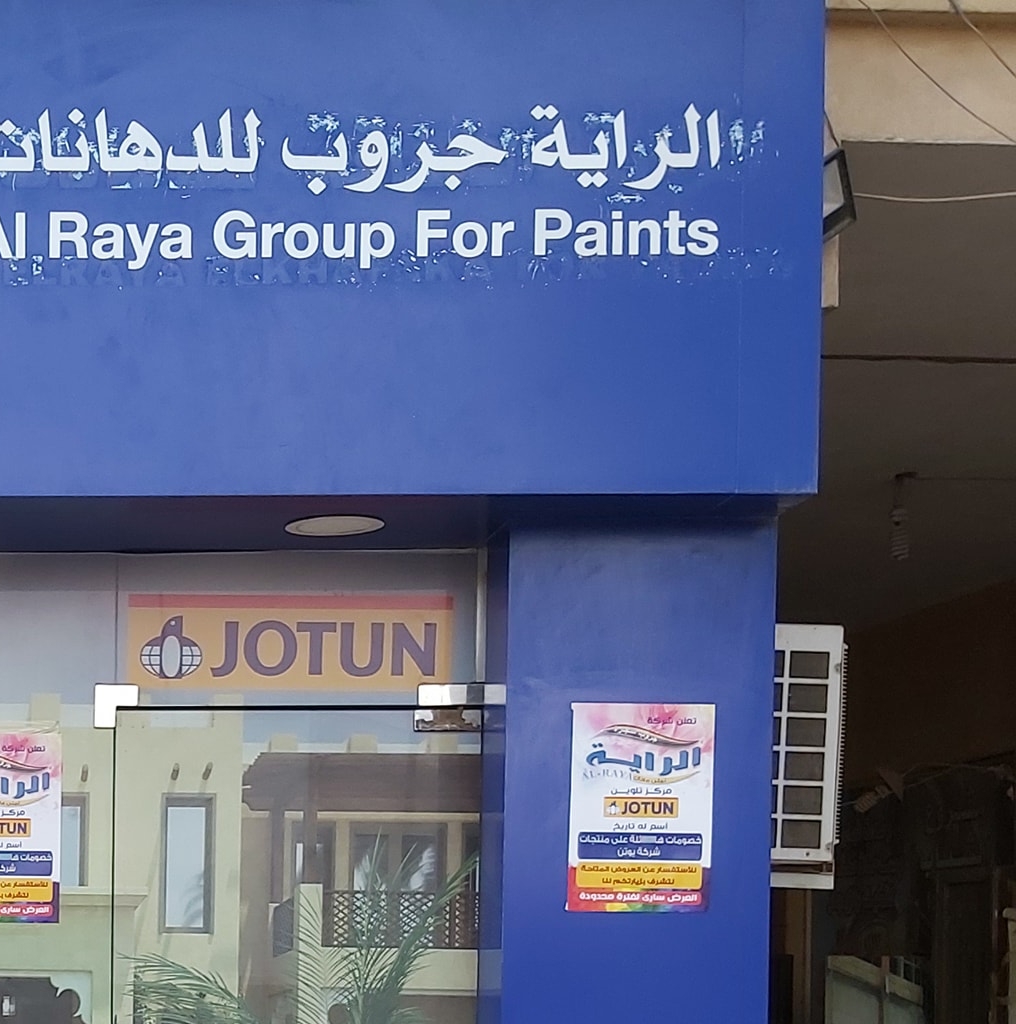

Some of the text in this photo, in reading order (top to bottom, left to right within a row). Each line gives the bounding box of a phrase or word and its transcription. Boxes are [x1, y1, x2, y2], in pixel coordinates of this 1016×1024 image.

[530, 103, 721, 190] الراية
[281, 126, 508, 193] جروب
[49, 211, 194, 269] Raya
[213, 209, 396, 269] Group
[417, 210, 516, 258] For
[533, 207, 721, 257] Paints
[210, 620, 438, 677] JOTUN
[586, 742, 702, 776] الراية
[611, 787, 672, 795] مركز تلوين
[621, 801, 674, 815] JOTUN
[580, 834, 609, 846] منتجات
[666, 835, 702, 845] خصومات
[20, 852, 53, 862] خصومات
[637, 846, 661, 857] شركة
[579, 892, 614, 902] محدودة
